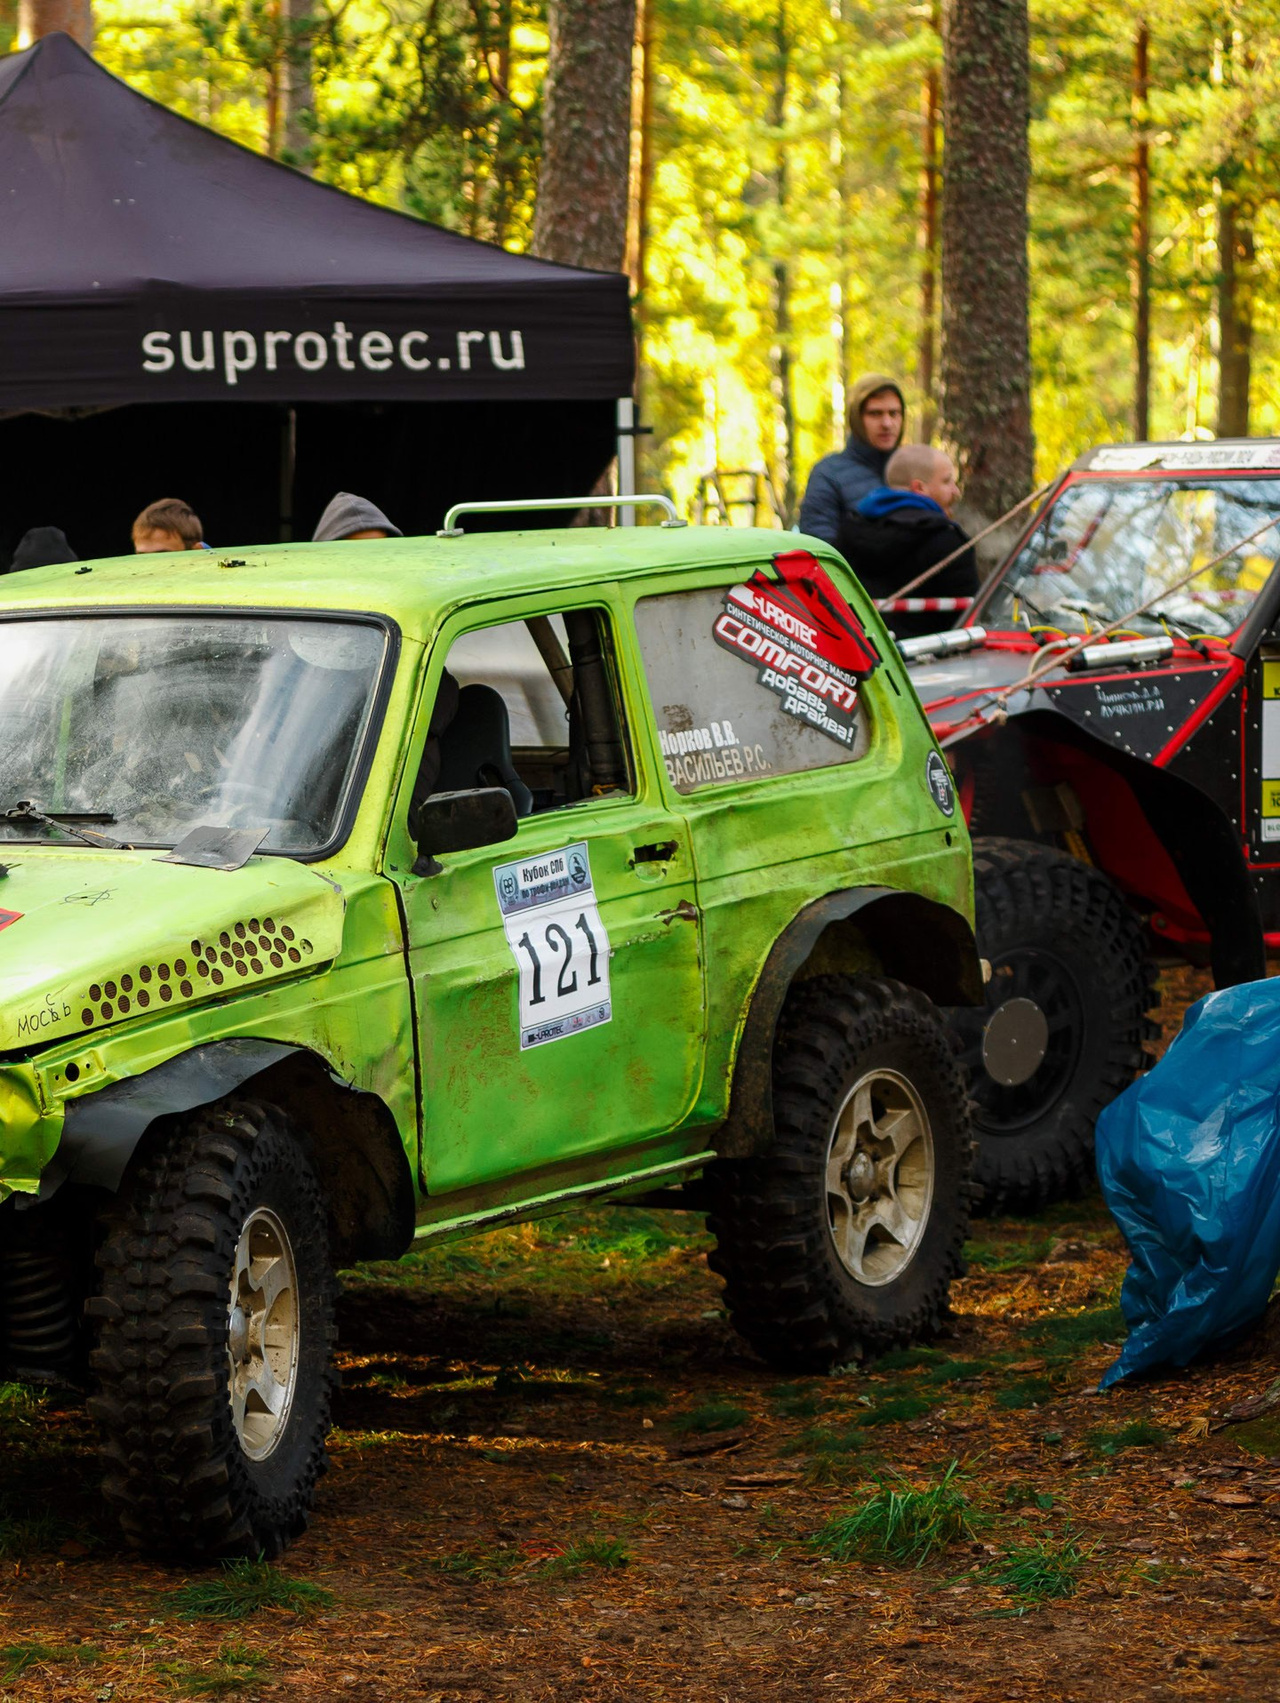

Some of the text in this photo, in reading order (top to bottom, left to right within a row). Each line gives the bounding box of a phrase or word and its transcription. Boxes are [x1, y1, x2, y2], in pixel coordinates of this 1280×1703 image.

[142, 321, 526, 385] suprotec.ru
[715, 615, 858, 710] COMFORT
[727, 603, 858, 688] СИНТЕТИЧЕСКОЕ МОТОРНОЕ МАСЛО
[522, 858, 564, 883] Кубок СПб
[518, 913, 601, 1006] 121
